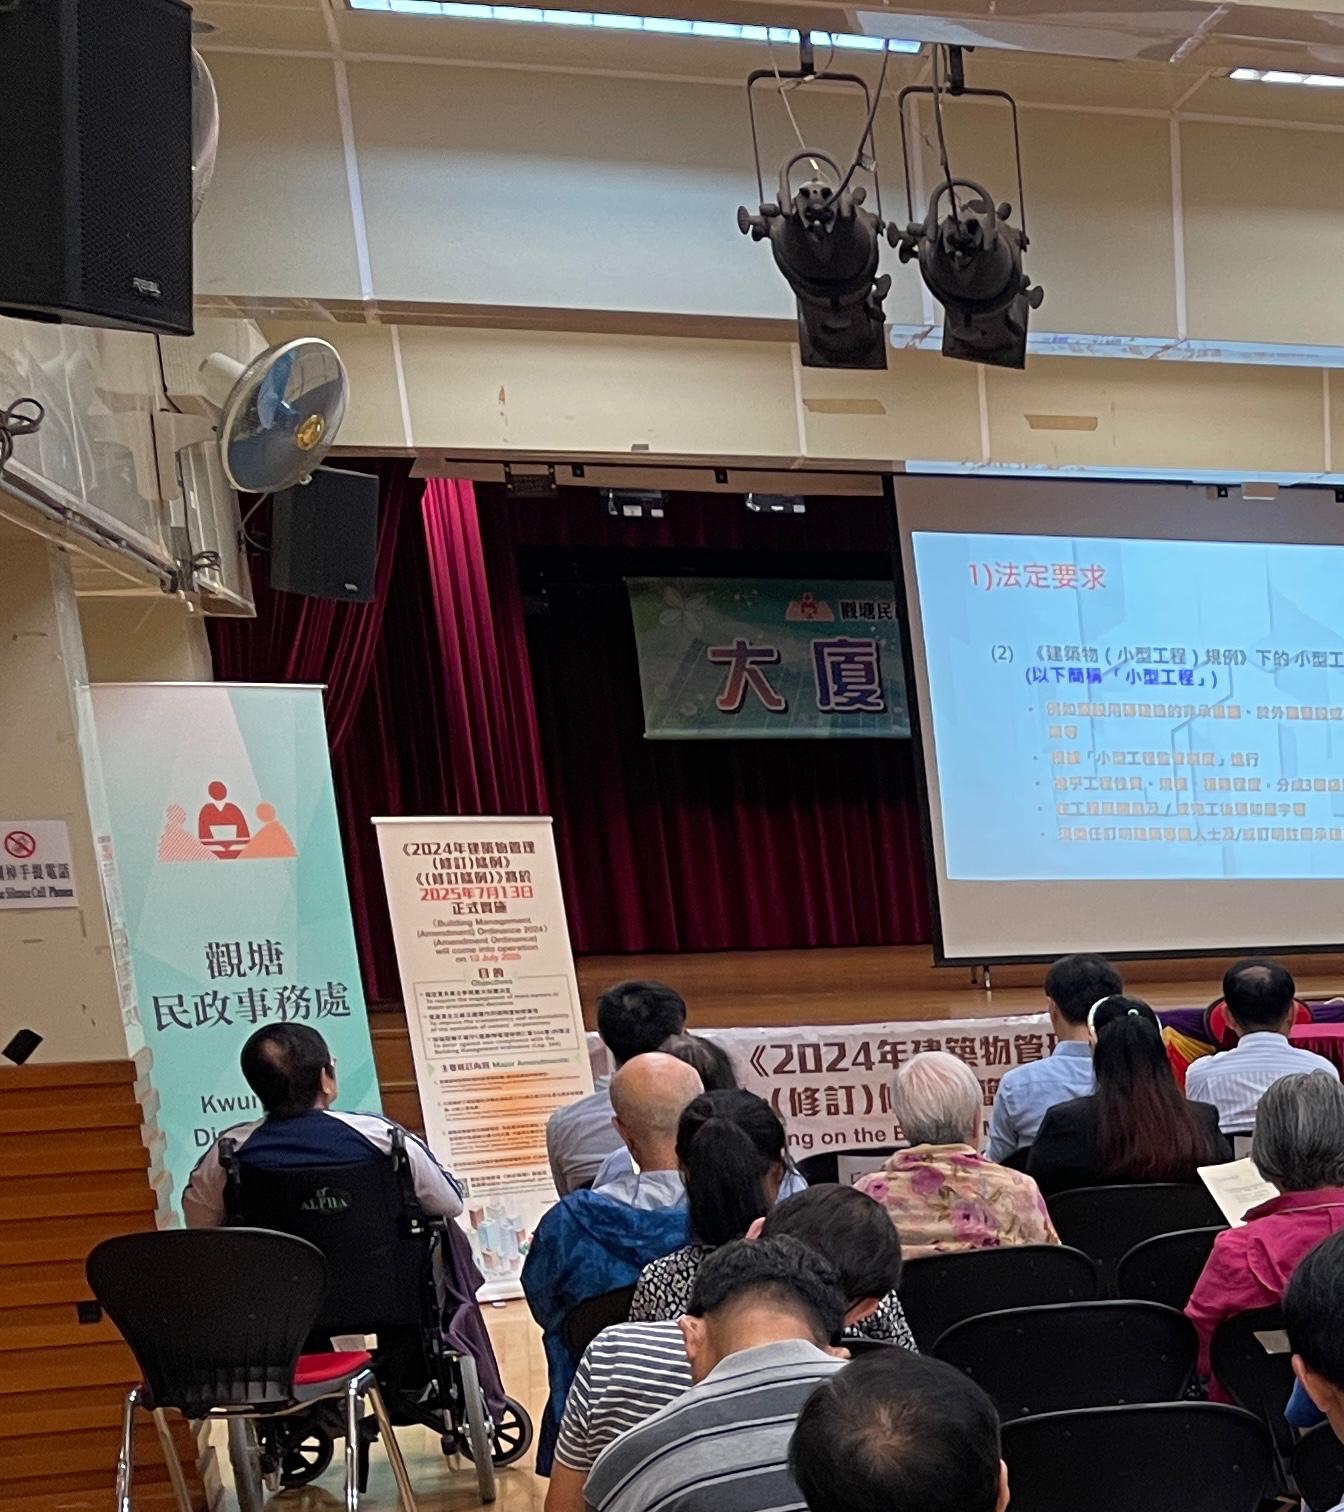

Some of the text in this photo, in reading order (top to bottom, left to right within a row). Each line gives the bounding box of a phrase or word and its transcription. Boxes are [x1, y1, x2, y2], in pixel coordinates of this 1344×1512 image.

[968, 562, 1107, 591] 1)法定要求
[991, 645, 1014, 663] (2)
[707, 636, 885, 711] 大廈
[420, 886, 534, 900] 2025年7月13日
[204, 939, 284, 979] 觀塘
[152, 981, 352, 1032] 民政事務處
[821, 1130, 847, 1145] on
[853, 1127, 886, 1143] the
